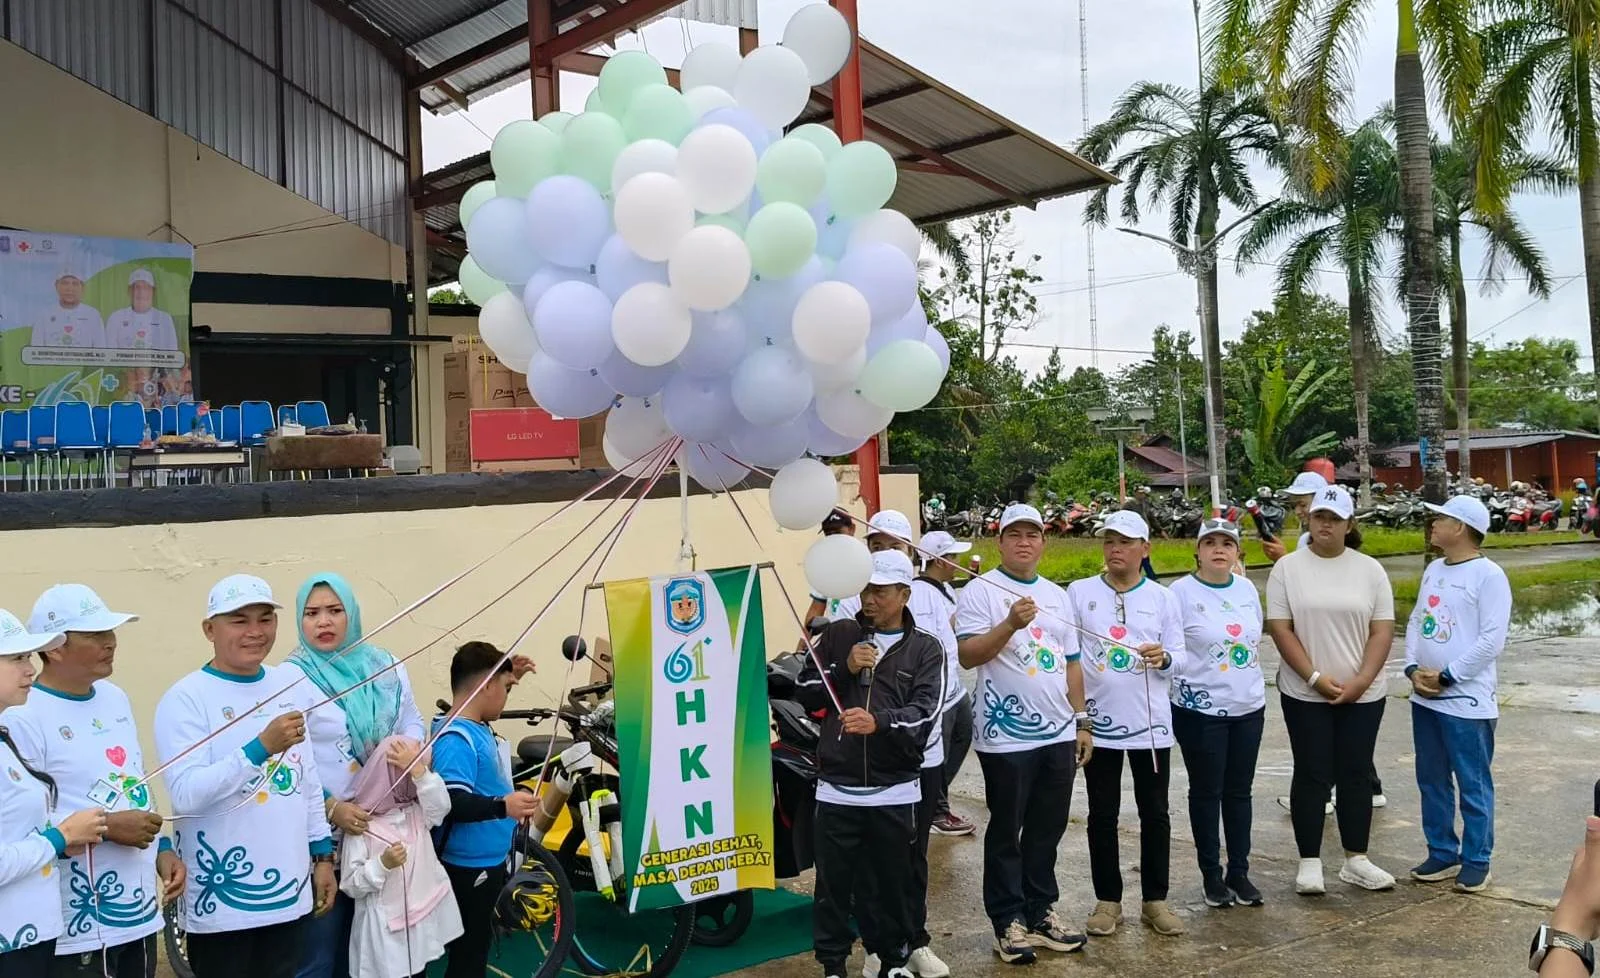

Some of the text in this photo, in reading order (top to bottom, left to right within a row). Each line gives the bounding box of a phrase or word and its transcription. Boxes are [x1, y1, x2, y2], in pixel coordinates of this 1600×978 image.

[641, 834, 762, 867] GENERASI SEHAT,
[633, 851, 771, 888] MASA DEPAN HEBAT
[690, 877, 719, 896] 2025
